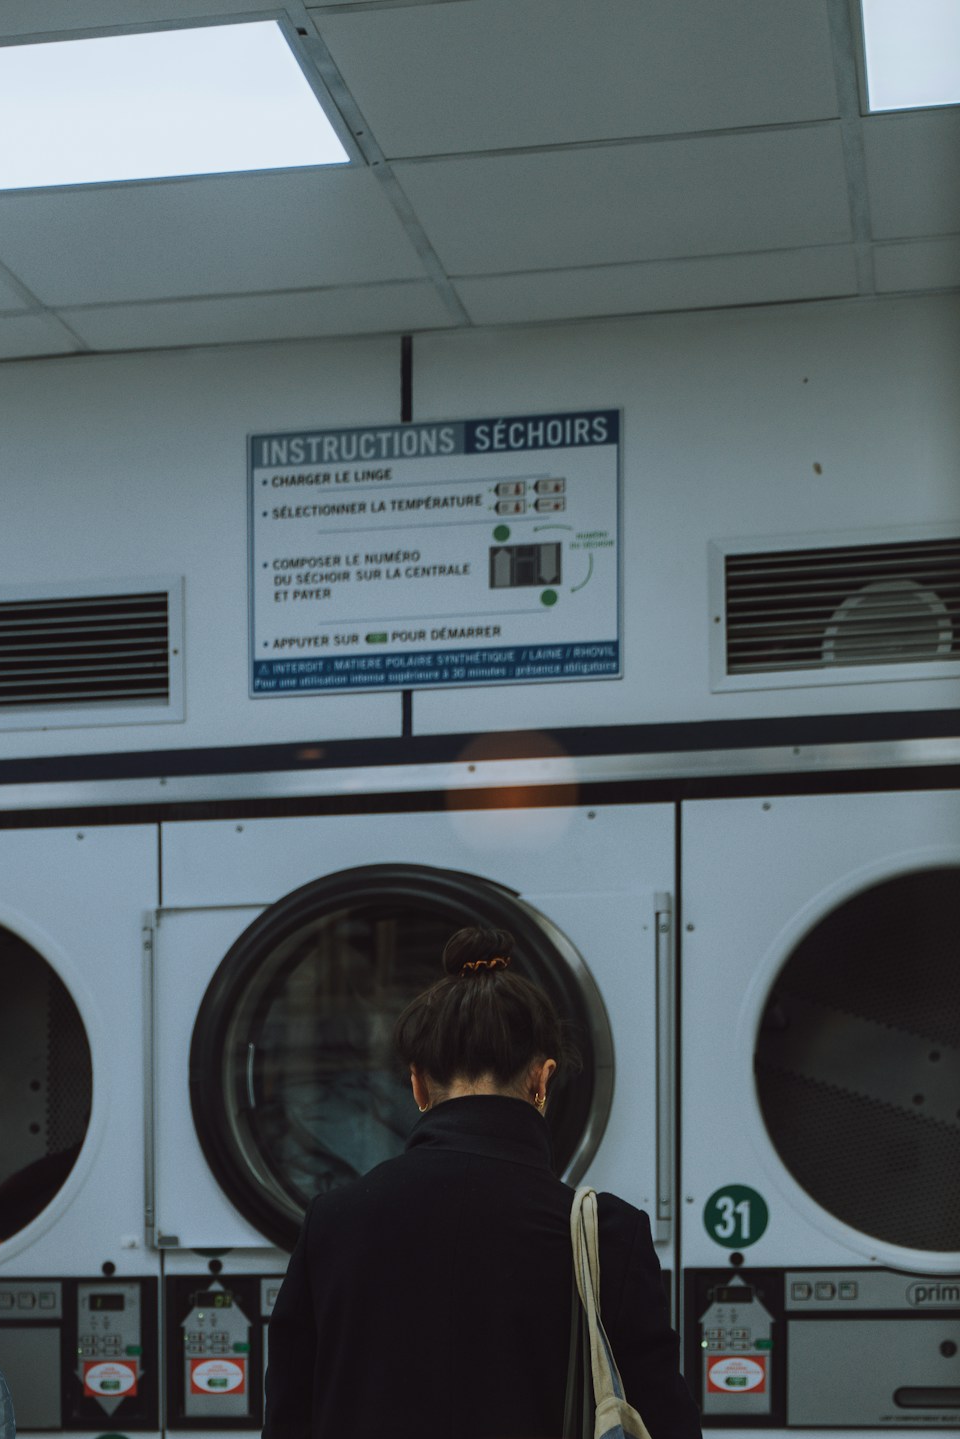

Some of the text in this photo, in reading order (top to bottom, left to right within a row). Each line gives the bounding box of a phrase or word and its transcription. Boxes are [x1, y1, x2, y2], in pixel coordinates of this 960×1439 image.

[261, 417, 608, 466] INSTRUCTIONS SÉCHOIRS
[272, 469, 392, 488] CHARGER LE LINGE
[273, 495, 482, 520] SÉLECTIONNER LA TEMPÉRATURE
[274, 550, 421, 570] COMPOSER LE NUMÉRO
[274, 564, 470, 586] DU SÉCHOIR SUR LA CENTRALE
[274, 588, 331, 602] ET PAYER
[273, 635, 329, 650] APPUYER
[334, 634, 358, 646] SUR
[392, 630, 425, 643] POUR
[431, 626, 501, 641] DÉMARRER
[273, 661, 323, 674] INTERDIT
[386, 655, 433, 668] POLAIRE
[438, 650, 514, 666] SYNTHÉTIQUE
[714, 1195, 751, 1240] 31
